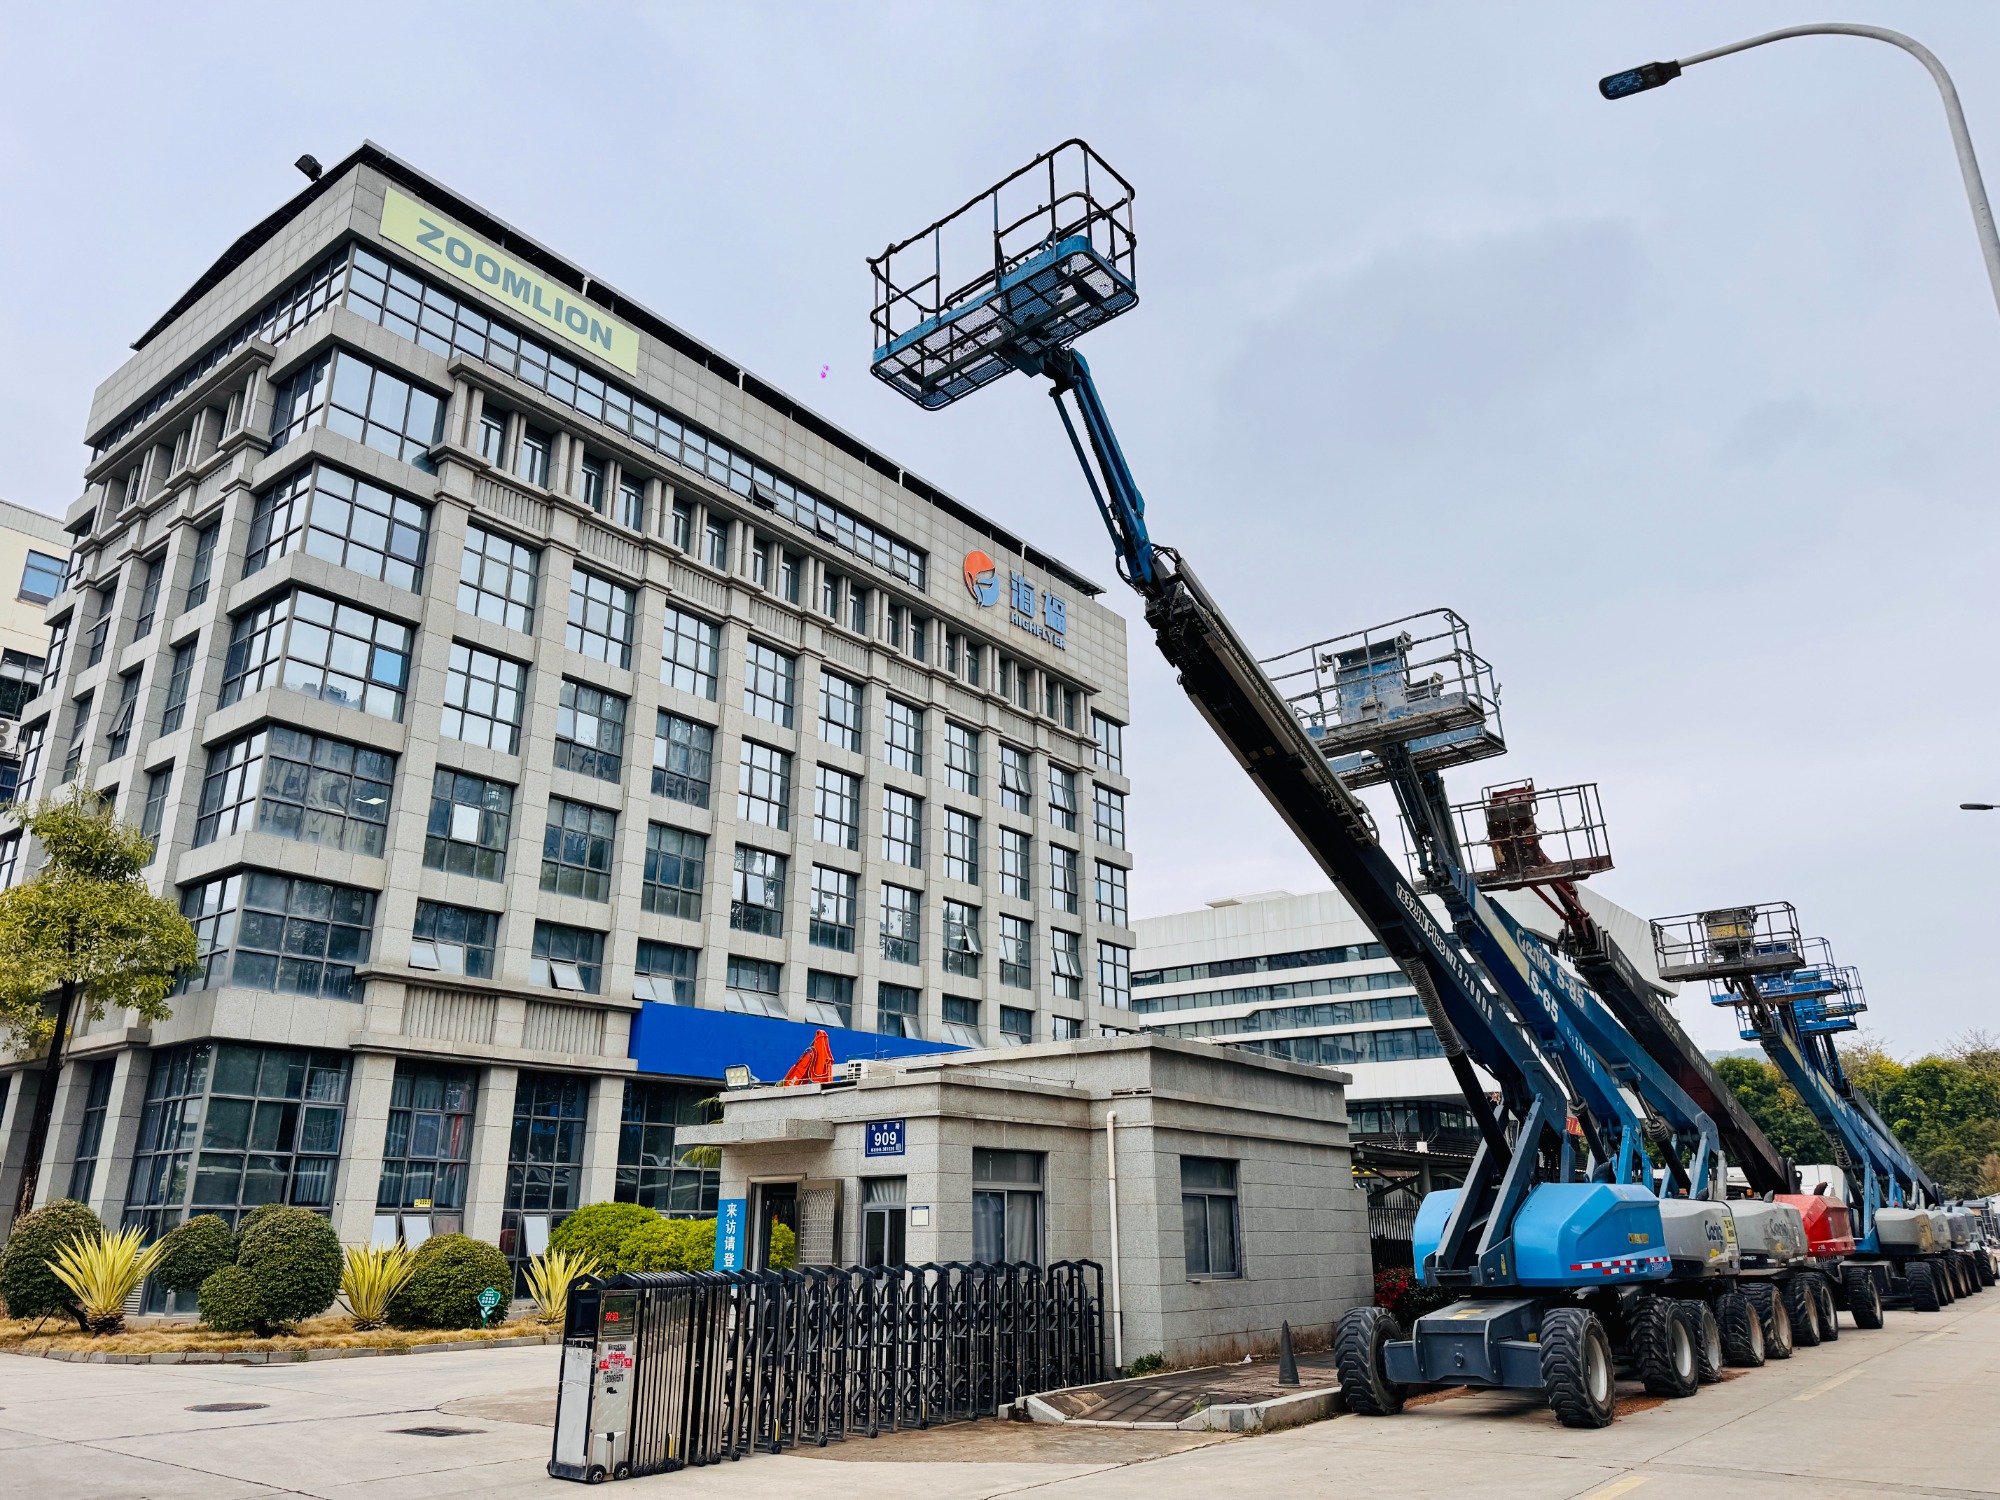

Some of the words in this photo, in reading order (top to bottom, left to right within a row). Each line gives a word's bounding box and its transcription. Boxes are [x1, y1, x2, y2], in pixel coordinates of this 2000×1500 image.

[416, 218, 613, 351] ZOOMLION
[1010, 612, 1066, 651] HIGHFLYER
[1427, 921, 1446, 956] Plus
[1516, 928, 1551, 980] Genie
[1557, 966, 1585, 1009] S-85
[1530, 970, 1559, 1023] S-65
[874, 1131, 897, 1146] 909
[723, 1202, 738, 1271] 来访请登
[1705, 1220, 1723, 1241] Genie
